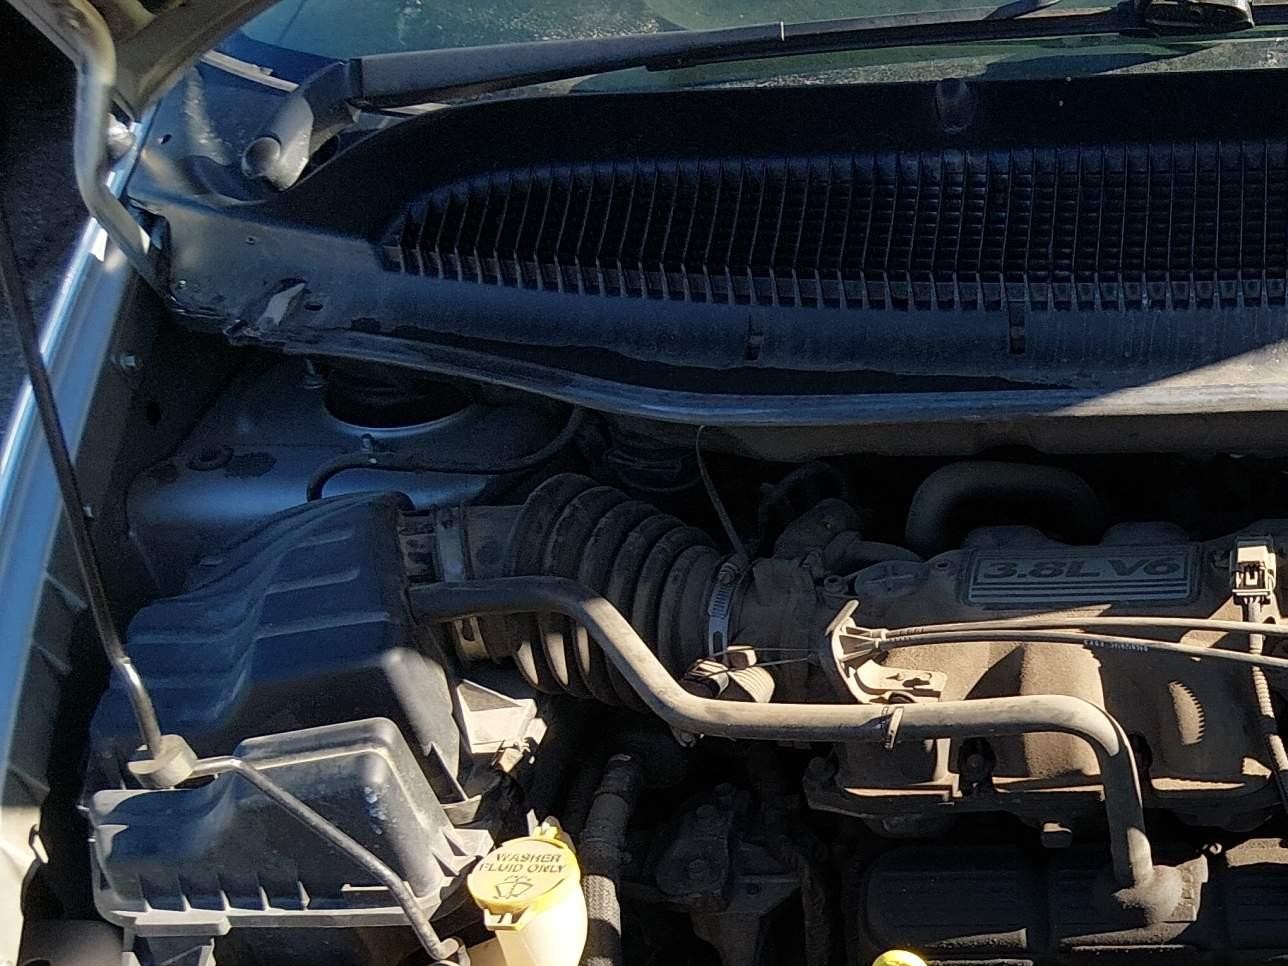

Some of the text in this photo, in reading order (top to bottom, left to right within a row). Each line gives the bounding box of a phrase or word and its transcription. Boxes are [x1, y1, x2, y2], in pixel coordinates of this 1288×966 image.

[984, 558, 1180, 578] 3.8L V6
[496, 853, 562, 862] WASHER
[480, 862, 568, 873] FLUID ONLY
